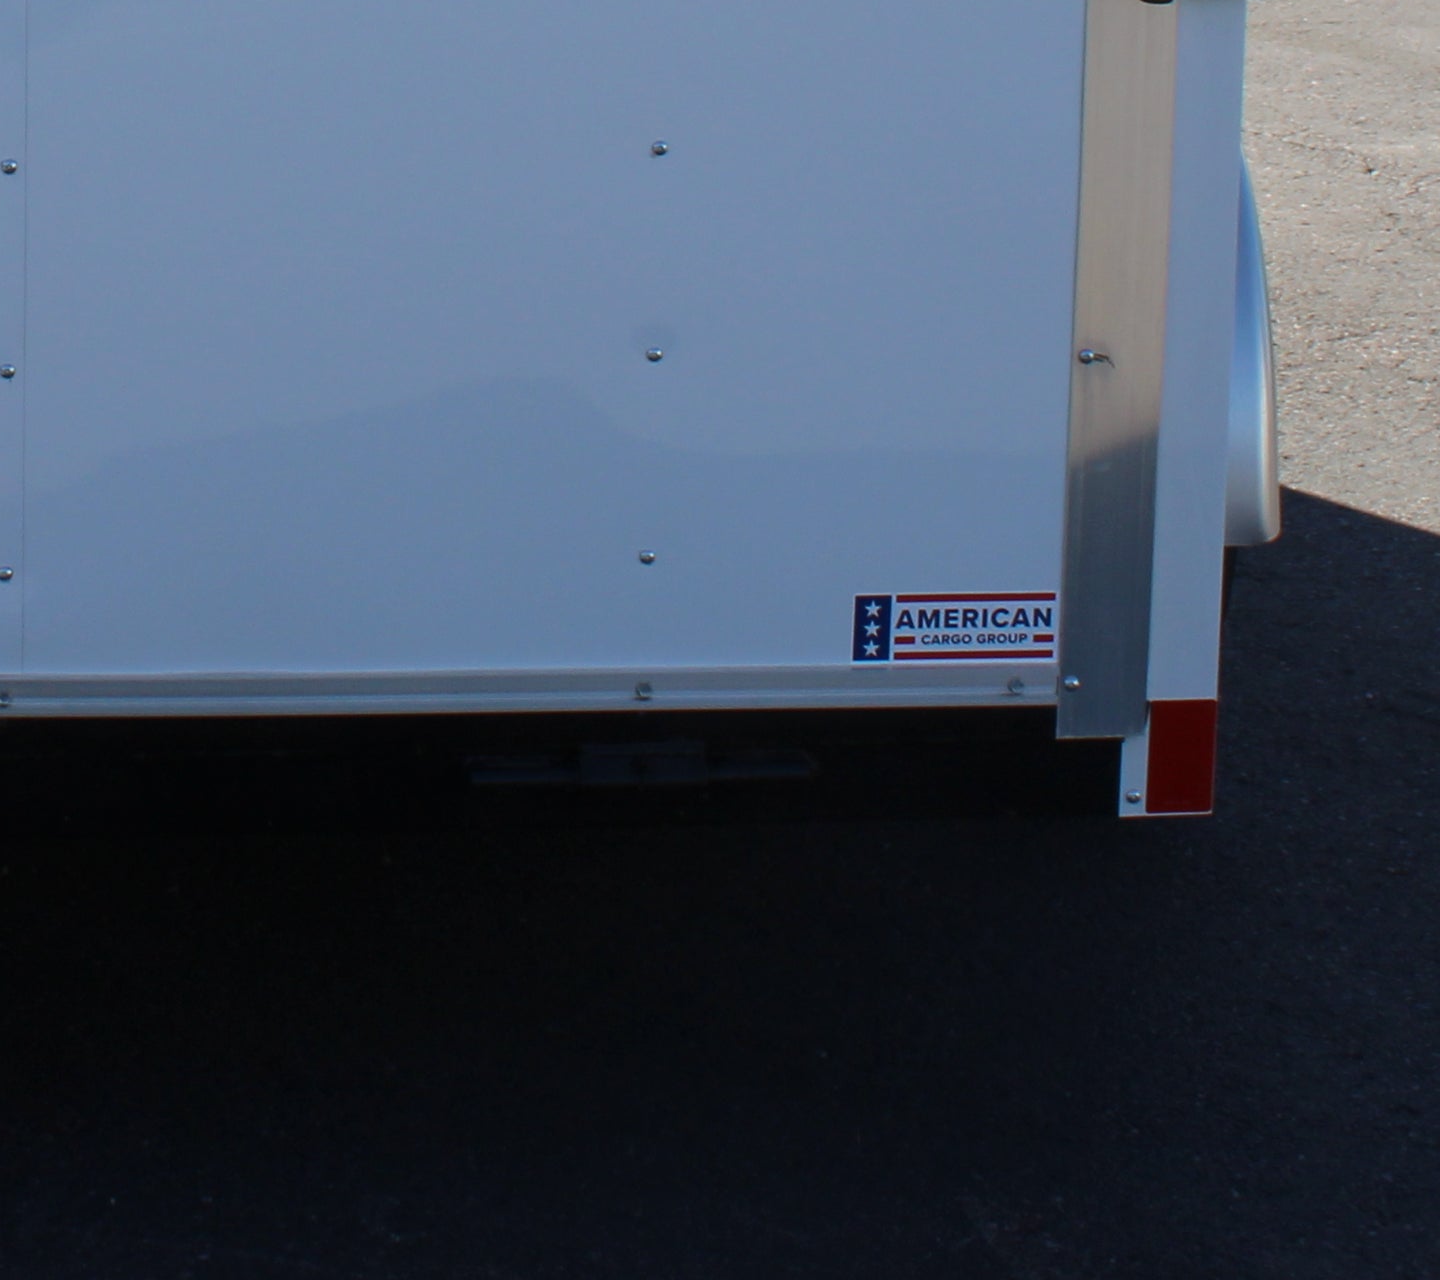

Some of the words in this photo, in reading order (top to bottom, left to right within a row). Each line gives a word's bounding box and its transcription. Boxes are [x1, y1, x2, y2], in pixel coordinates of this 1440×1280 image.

[895, 607, 1052, 629] AMERICAN
[921, 633, 972, 646] CARGO
[976, 633, 1028, 645] GROUP
